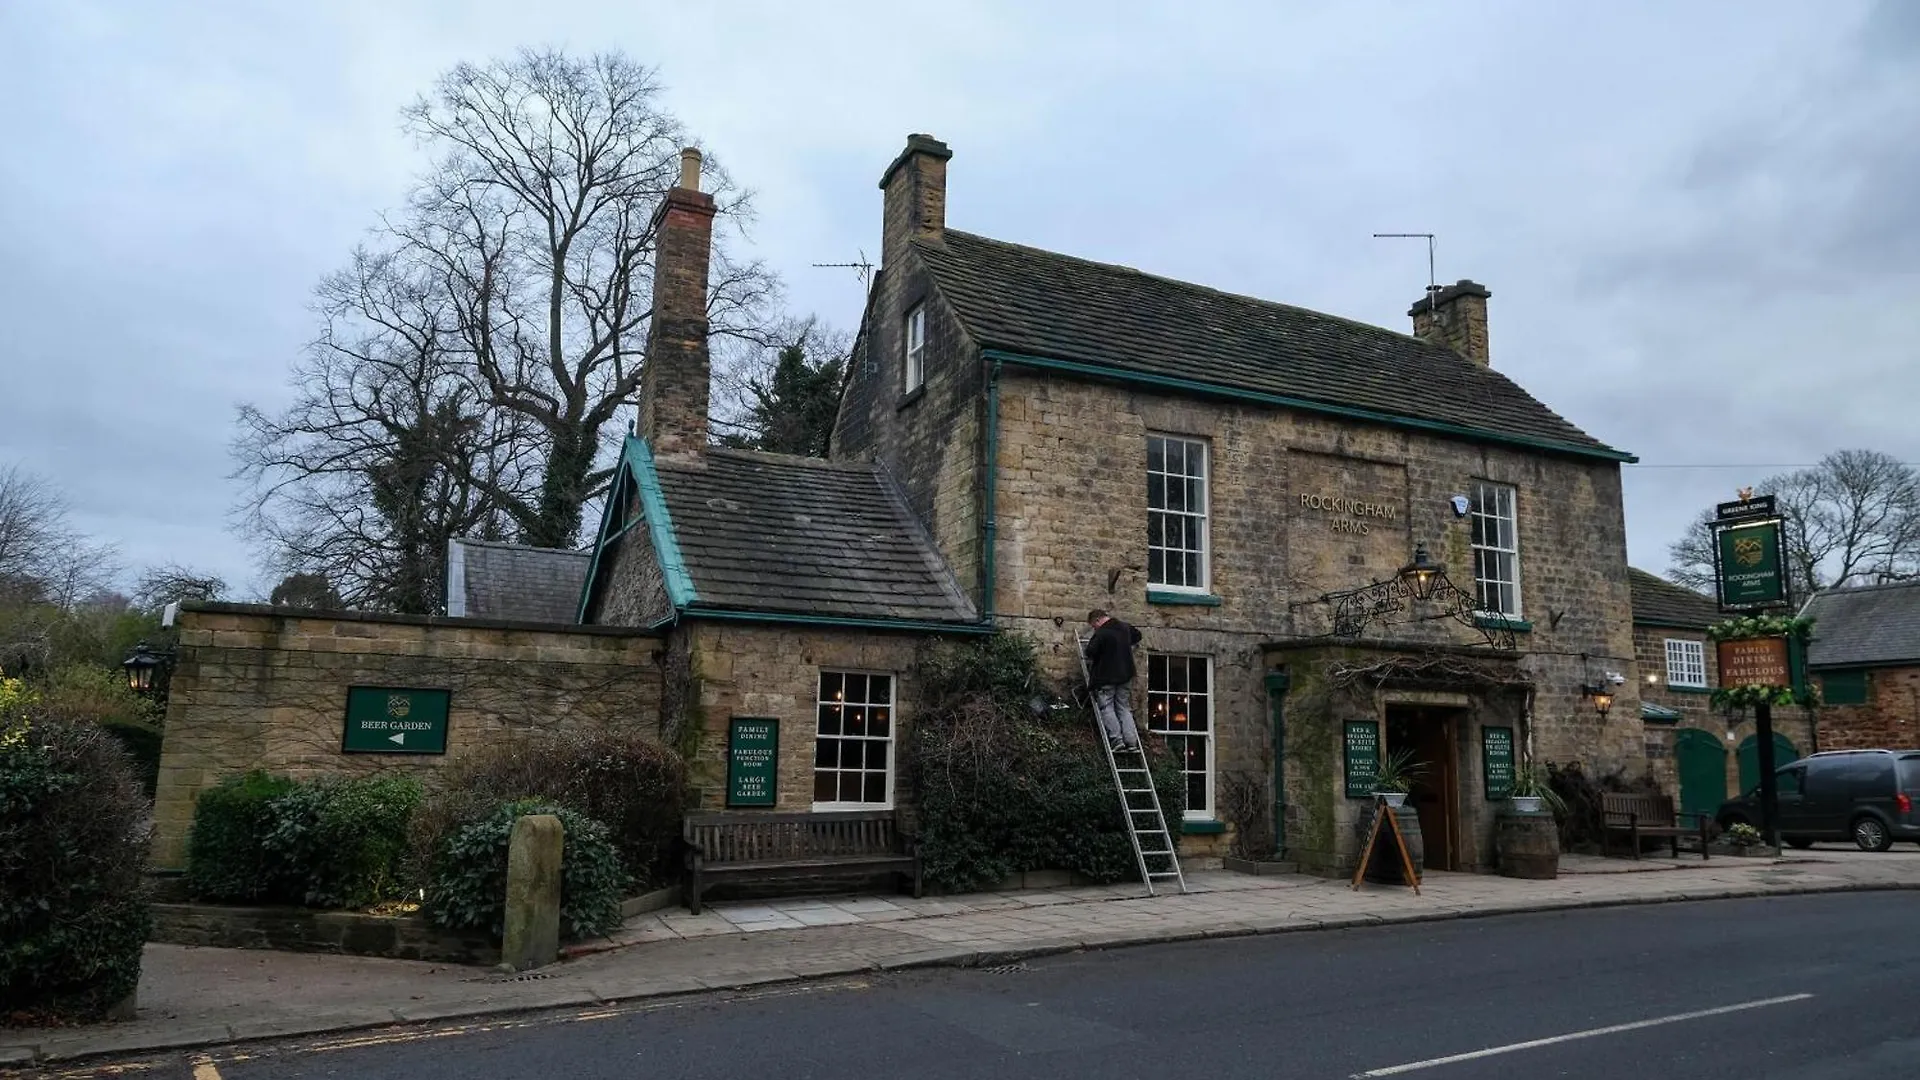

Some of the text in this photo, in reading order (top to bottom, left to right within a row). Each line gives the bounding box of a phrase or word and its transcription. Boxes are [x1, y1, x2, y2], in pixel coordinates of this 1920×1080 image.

[1301, 493, 1396, 519] ROCKINGHAM
[1331, 516, 1369, 536] ARMS
[1728, 570, 1775, 581] ROCKINGHAM
[1734, 646, 1770, 654] FAMILY
[1733, 654, 1775, 664] DINING
[1725, 666, 1785, 676] FABULOUS
[1735, 676, 1775, 685] GARDEN
[361, 720, 432, 730] BEER GARDEN
